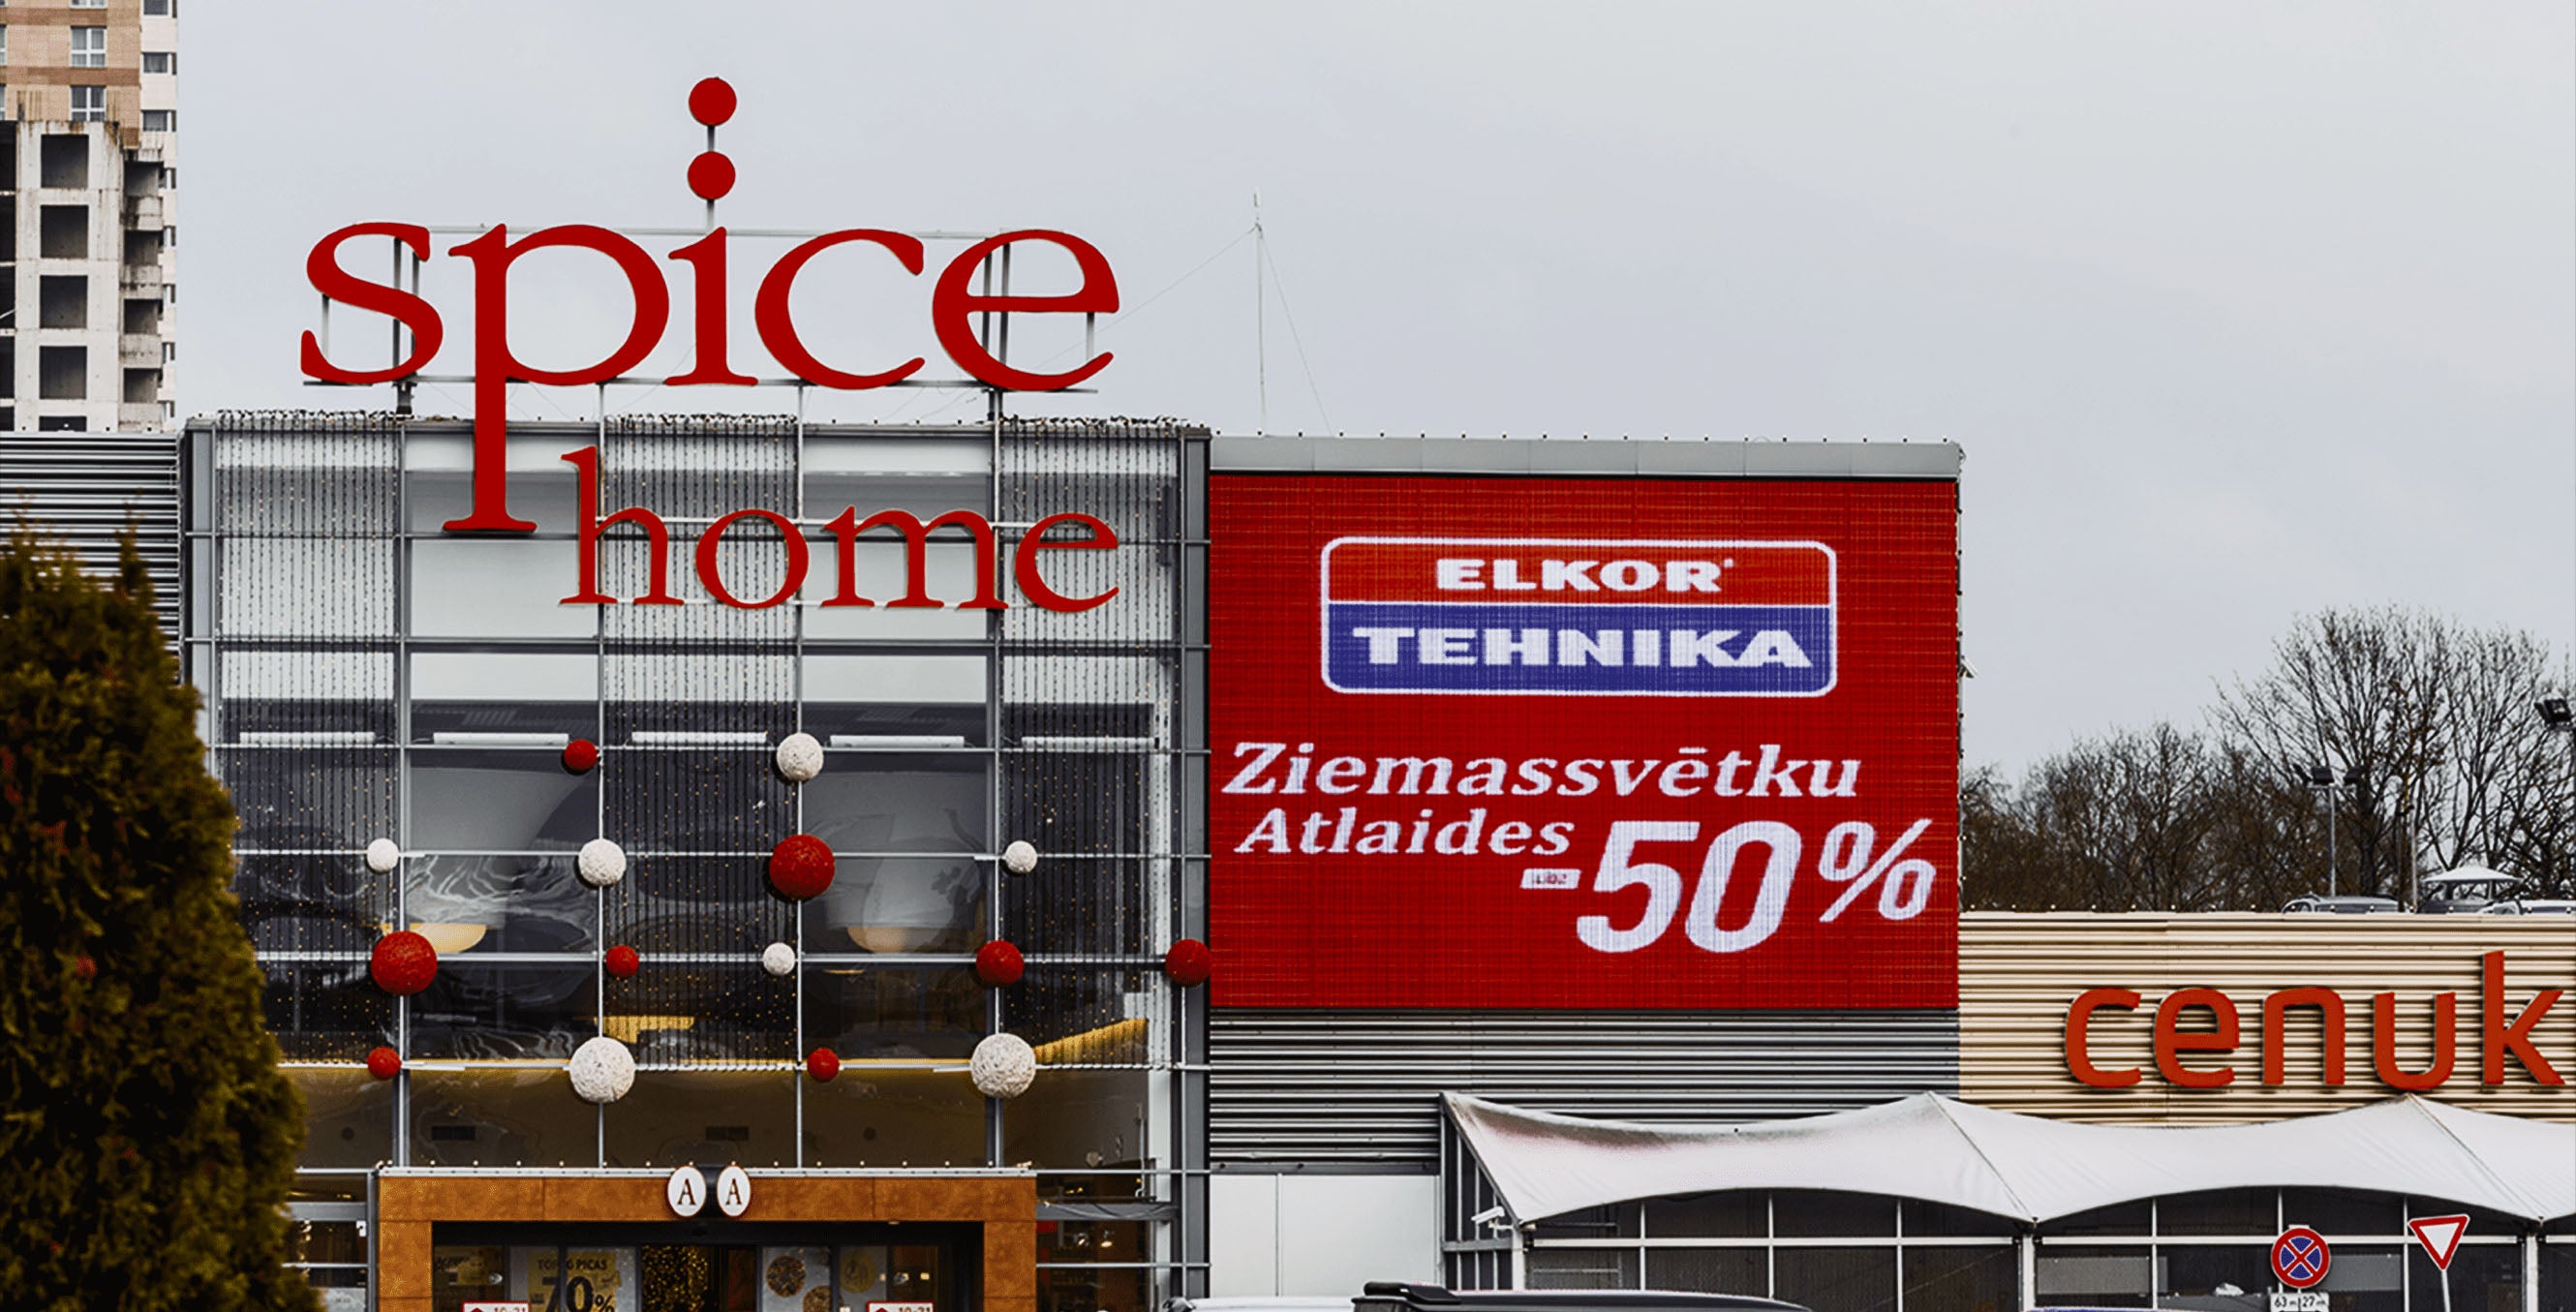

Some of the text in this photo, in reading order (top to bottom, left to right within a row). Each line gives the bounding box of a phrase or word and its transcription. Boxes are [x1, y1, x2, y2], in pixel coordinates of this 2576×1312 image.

[300, 76, 1120, 534] spice
[560, 445, 1120, 613] home
[1436, 558, 1723, 593] ELKOR
[1352, 627, 1813, 668] TEHNIKA
[1221, 742, 1861, 798] Ziemassvētku
[1234, 807, 1575, 856] Atlaides
[2065, 949, 2566, 1091] cenuk
[677, 1177, 696, 1205] A
[725, 1177, 743, 1205] A
